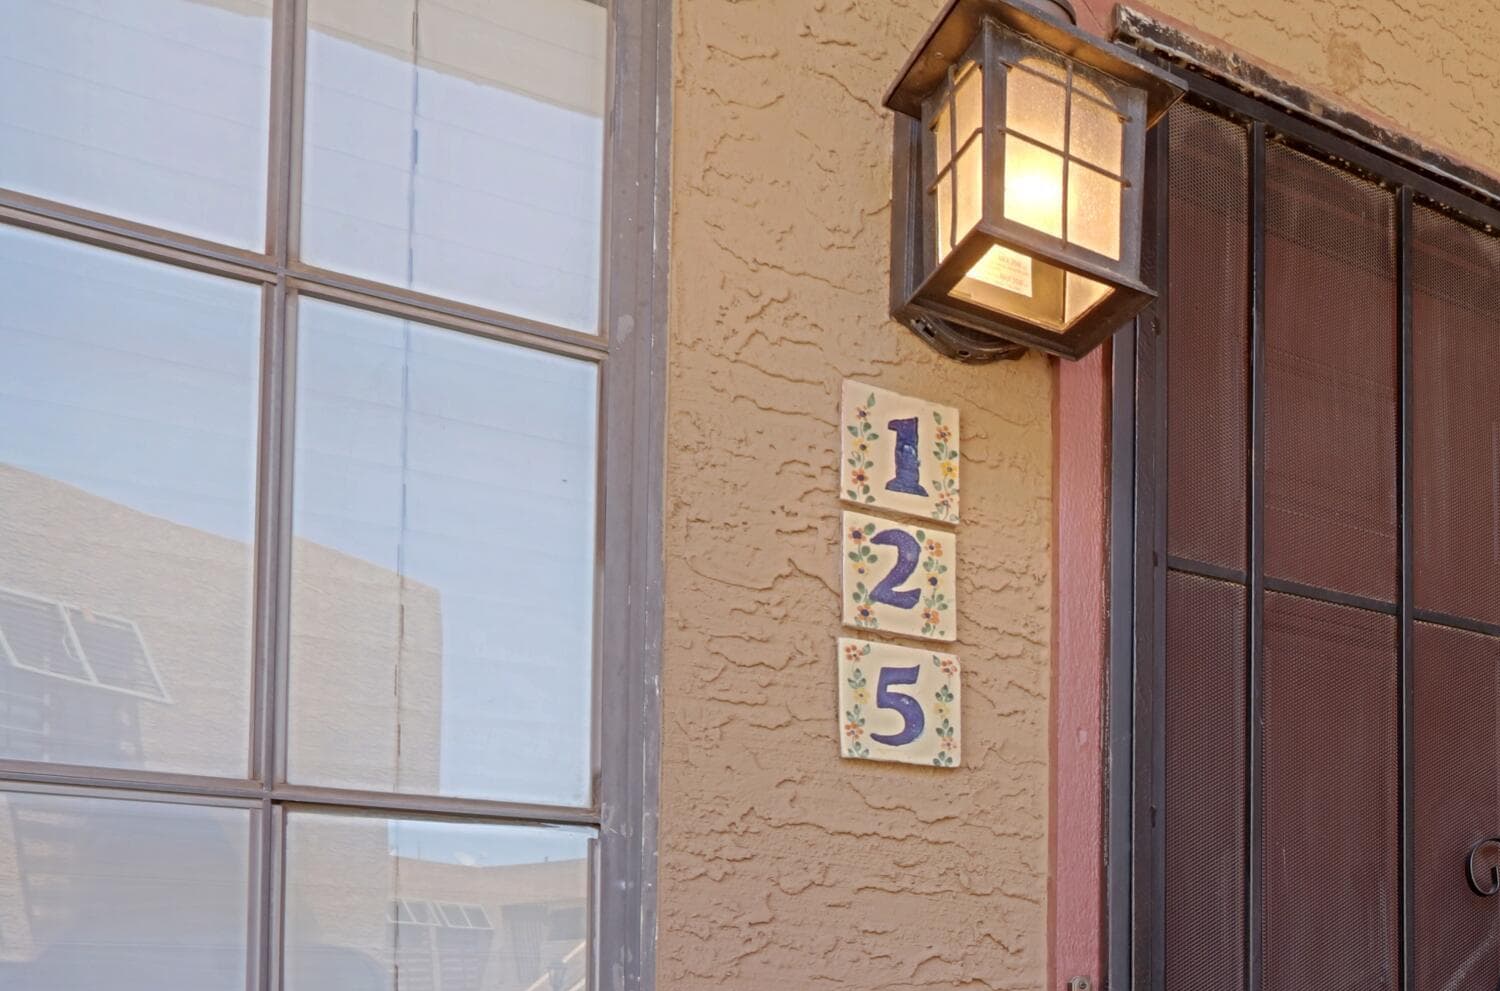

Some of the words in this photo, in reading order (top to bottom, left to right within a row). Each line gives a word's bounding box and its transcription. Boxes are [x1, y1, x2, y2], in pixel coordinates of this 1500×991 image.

[884, 416, 930, 498] 1
[868, 528, 922, 610] 2
[869, 664, 926, 747] 5
